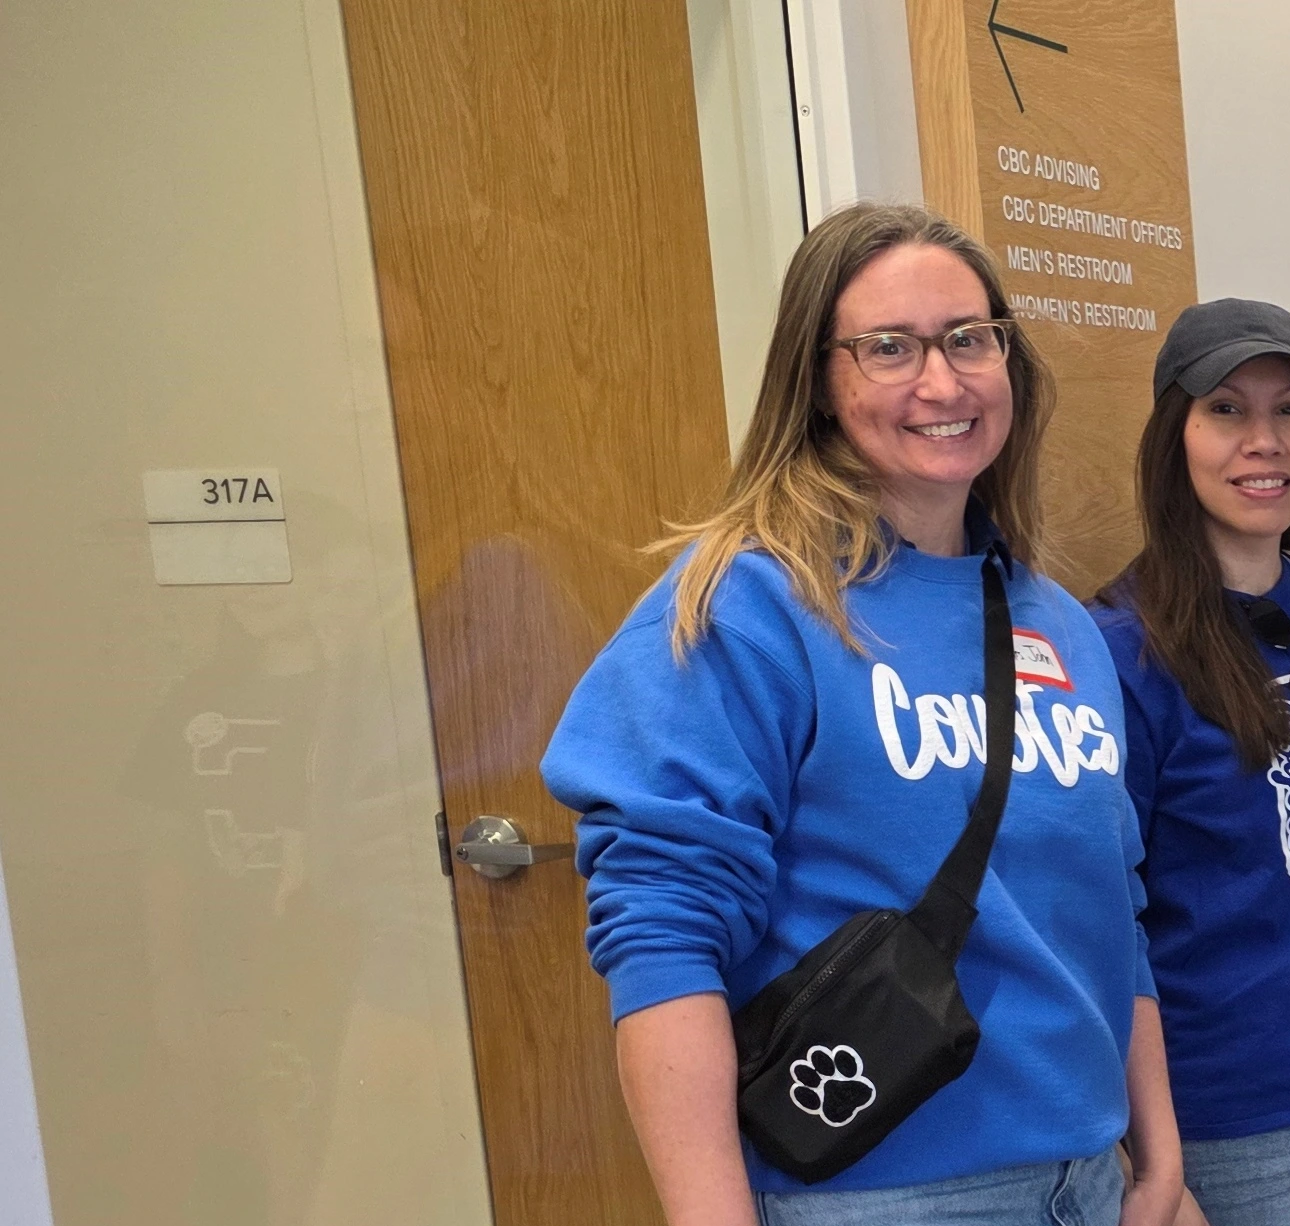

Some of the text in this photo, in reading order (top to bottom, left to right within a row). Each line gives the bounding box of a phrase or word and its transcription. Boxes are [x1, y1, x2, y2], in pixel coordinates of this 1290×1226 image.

[998, 145, 1100, 190] CBC ADVISING
[1002, 195, 1183, 250] CBC DEPARTMENT OFFICES
[1007, 245, 1133, 285] MEN'S RESTROOM
[1011, 293, 1157, 332] WOMEN'S RESTROOM
[202, 478, 274, 504] 317A
